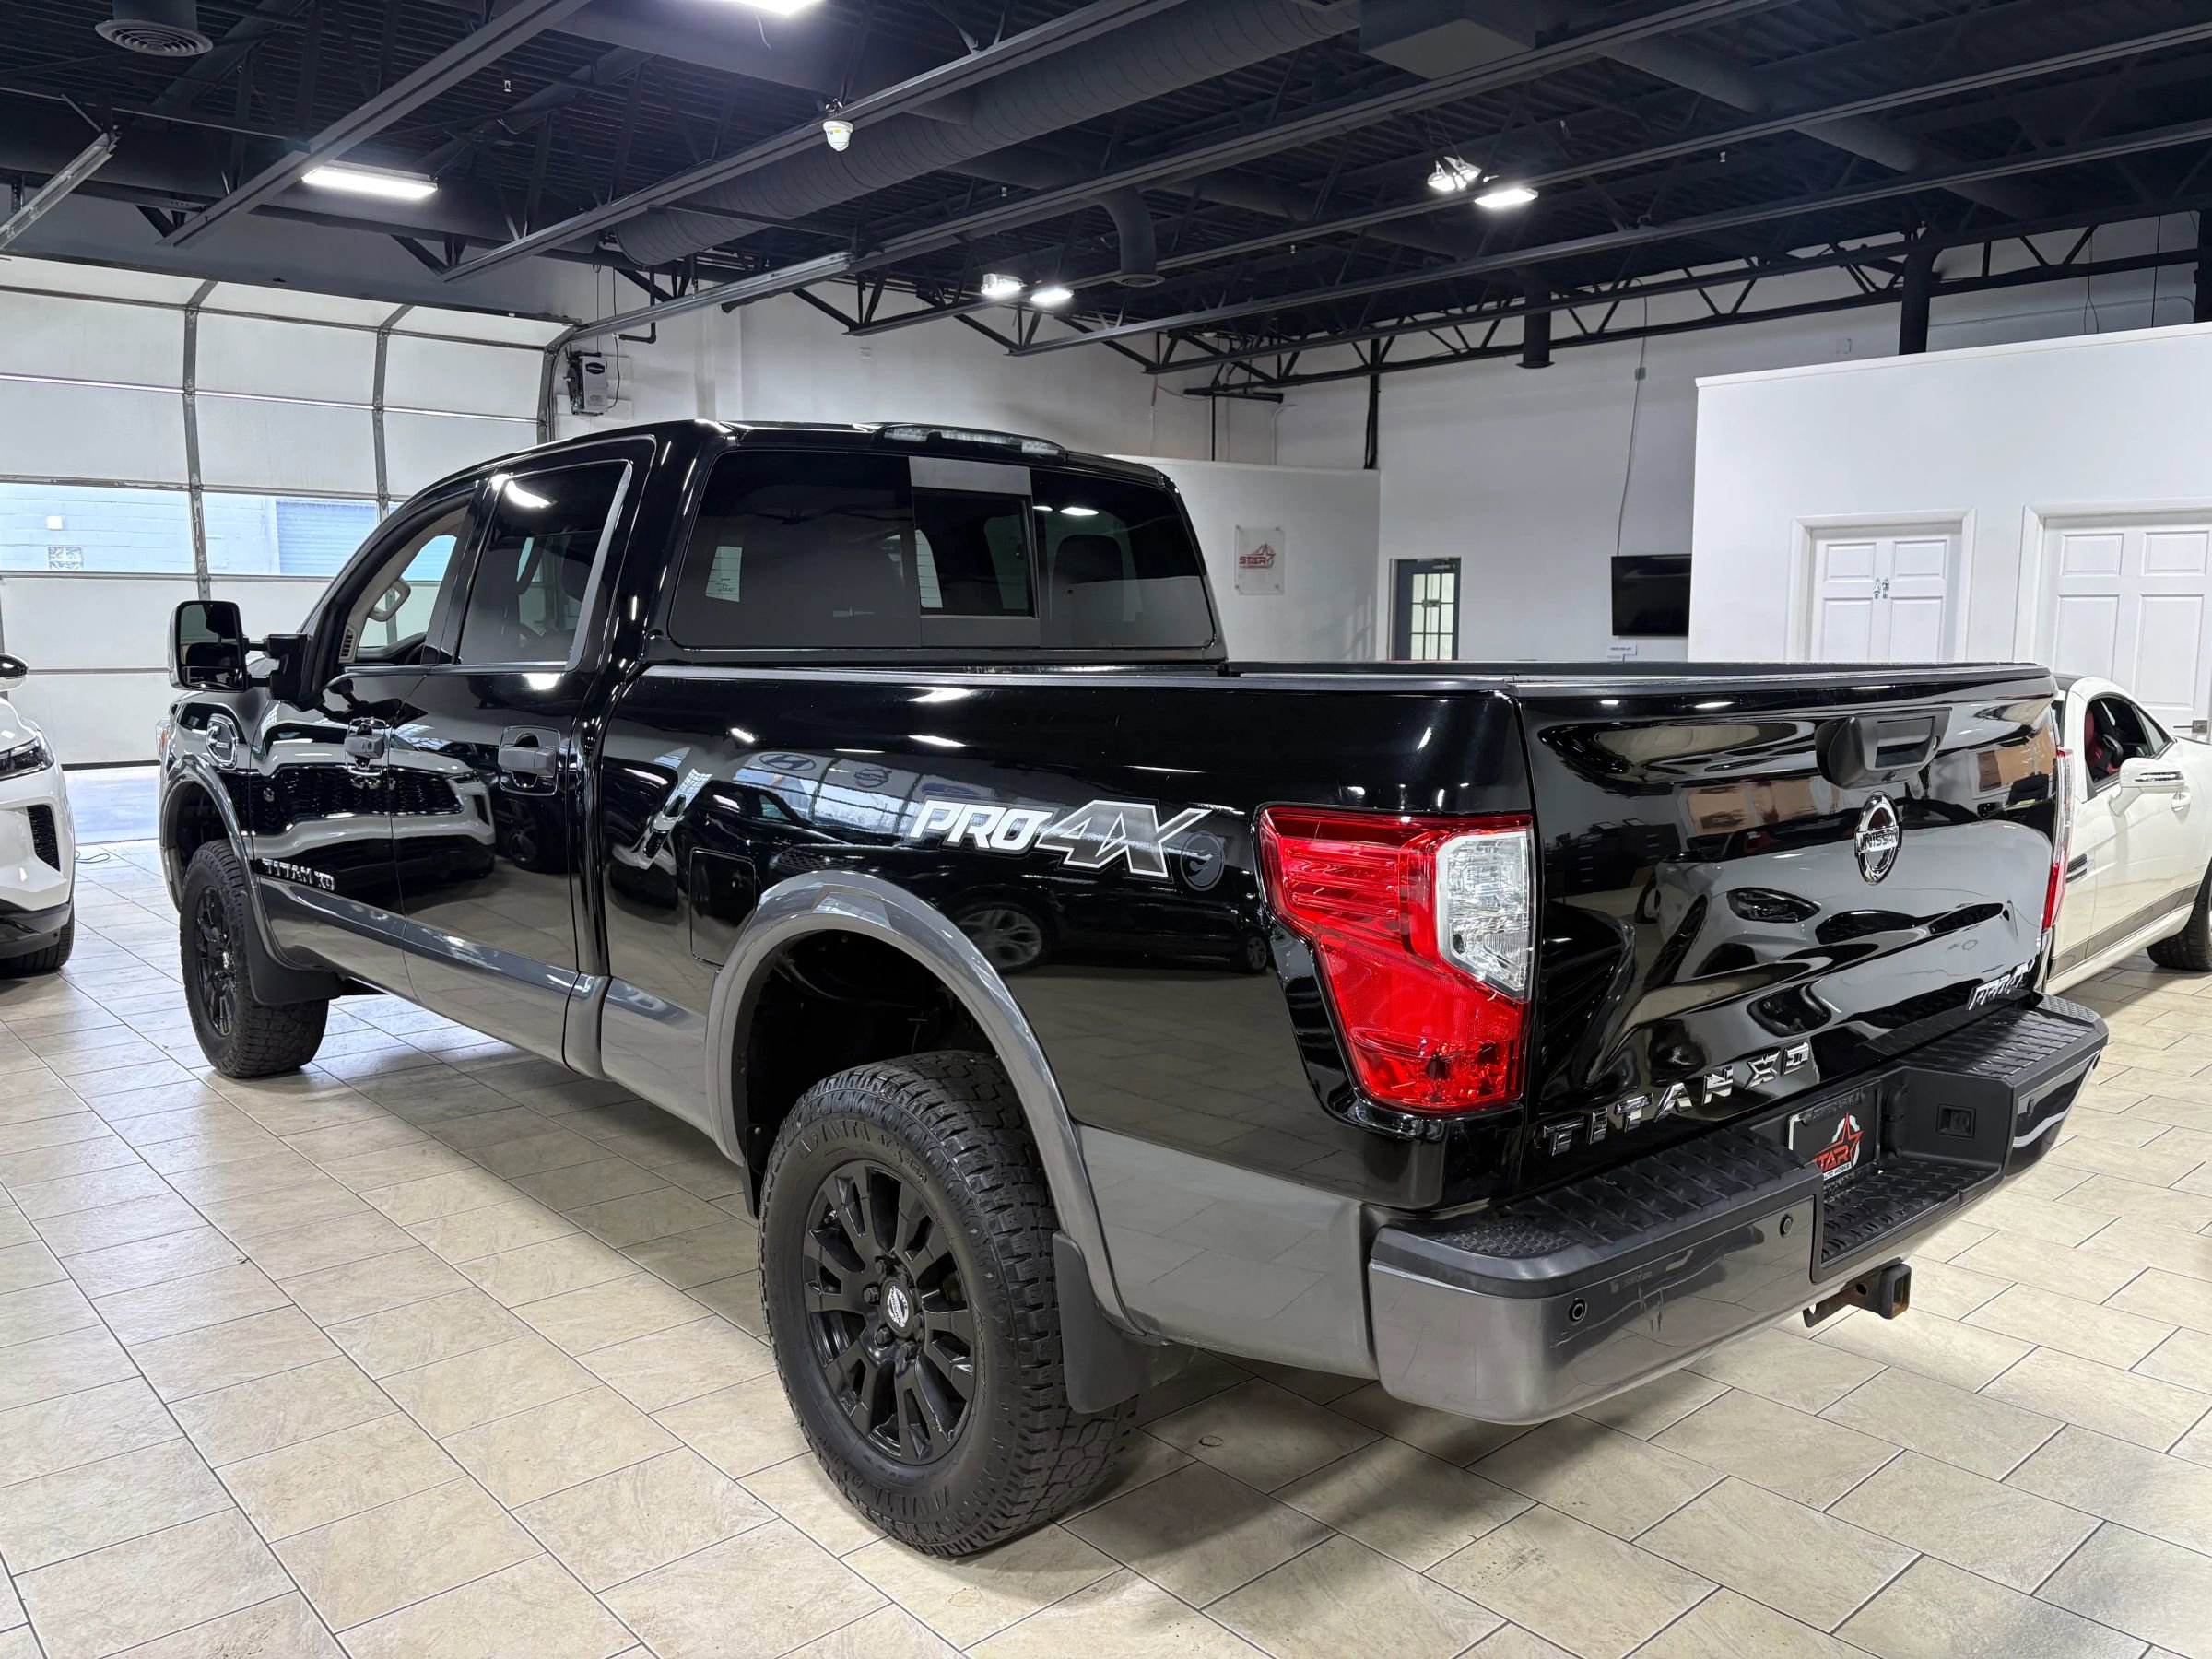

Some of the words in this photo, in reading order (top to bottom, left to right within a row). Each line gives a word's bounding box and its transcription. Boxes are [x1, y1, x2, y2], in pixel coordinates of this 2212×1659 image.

[261, 857, 312, 885] TITAN
[1543, 1065, 1734, 1157] TITAN
[1745, 1041, 1809, 1090] XD
